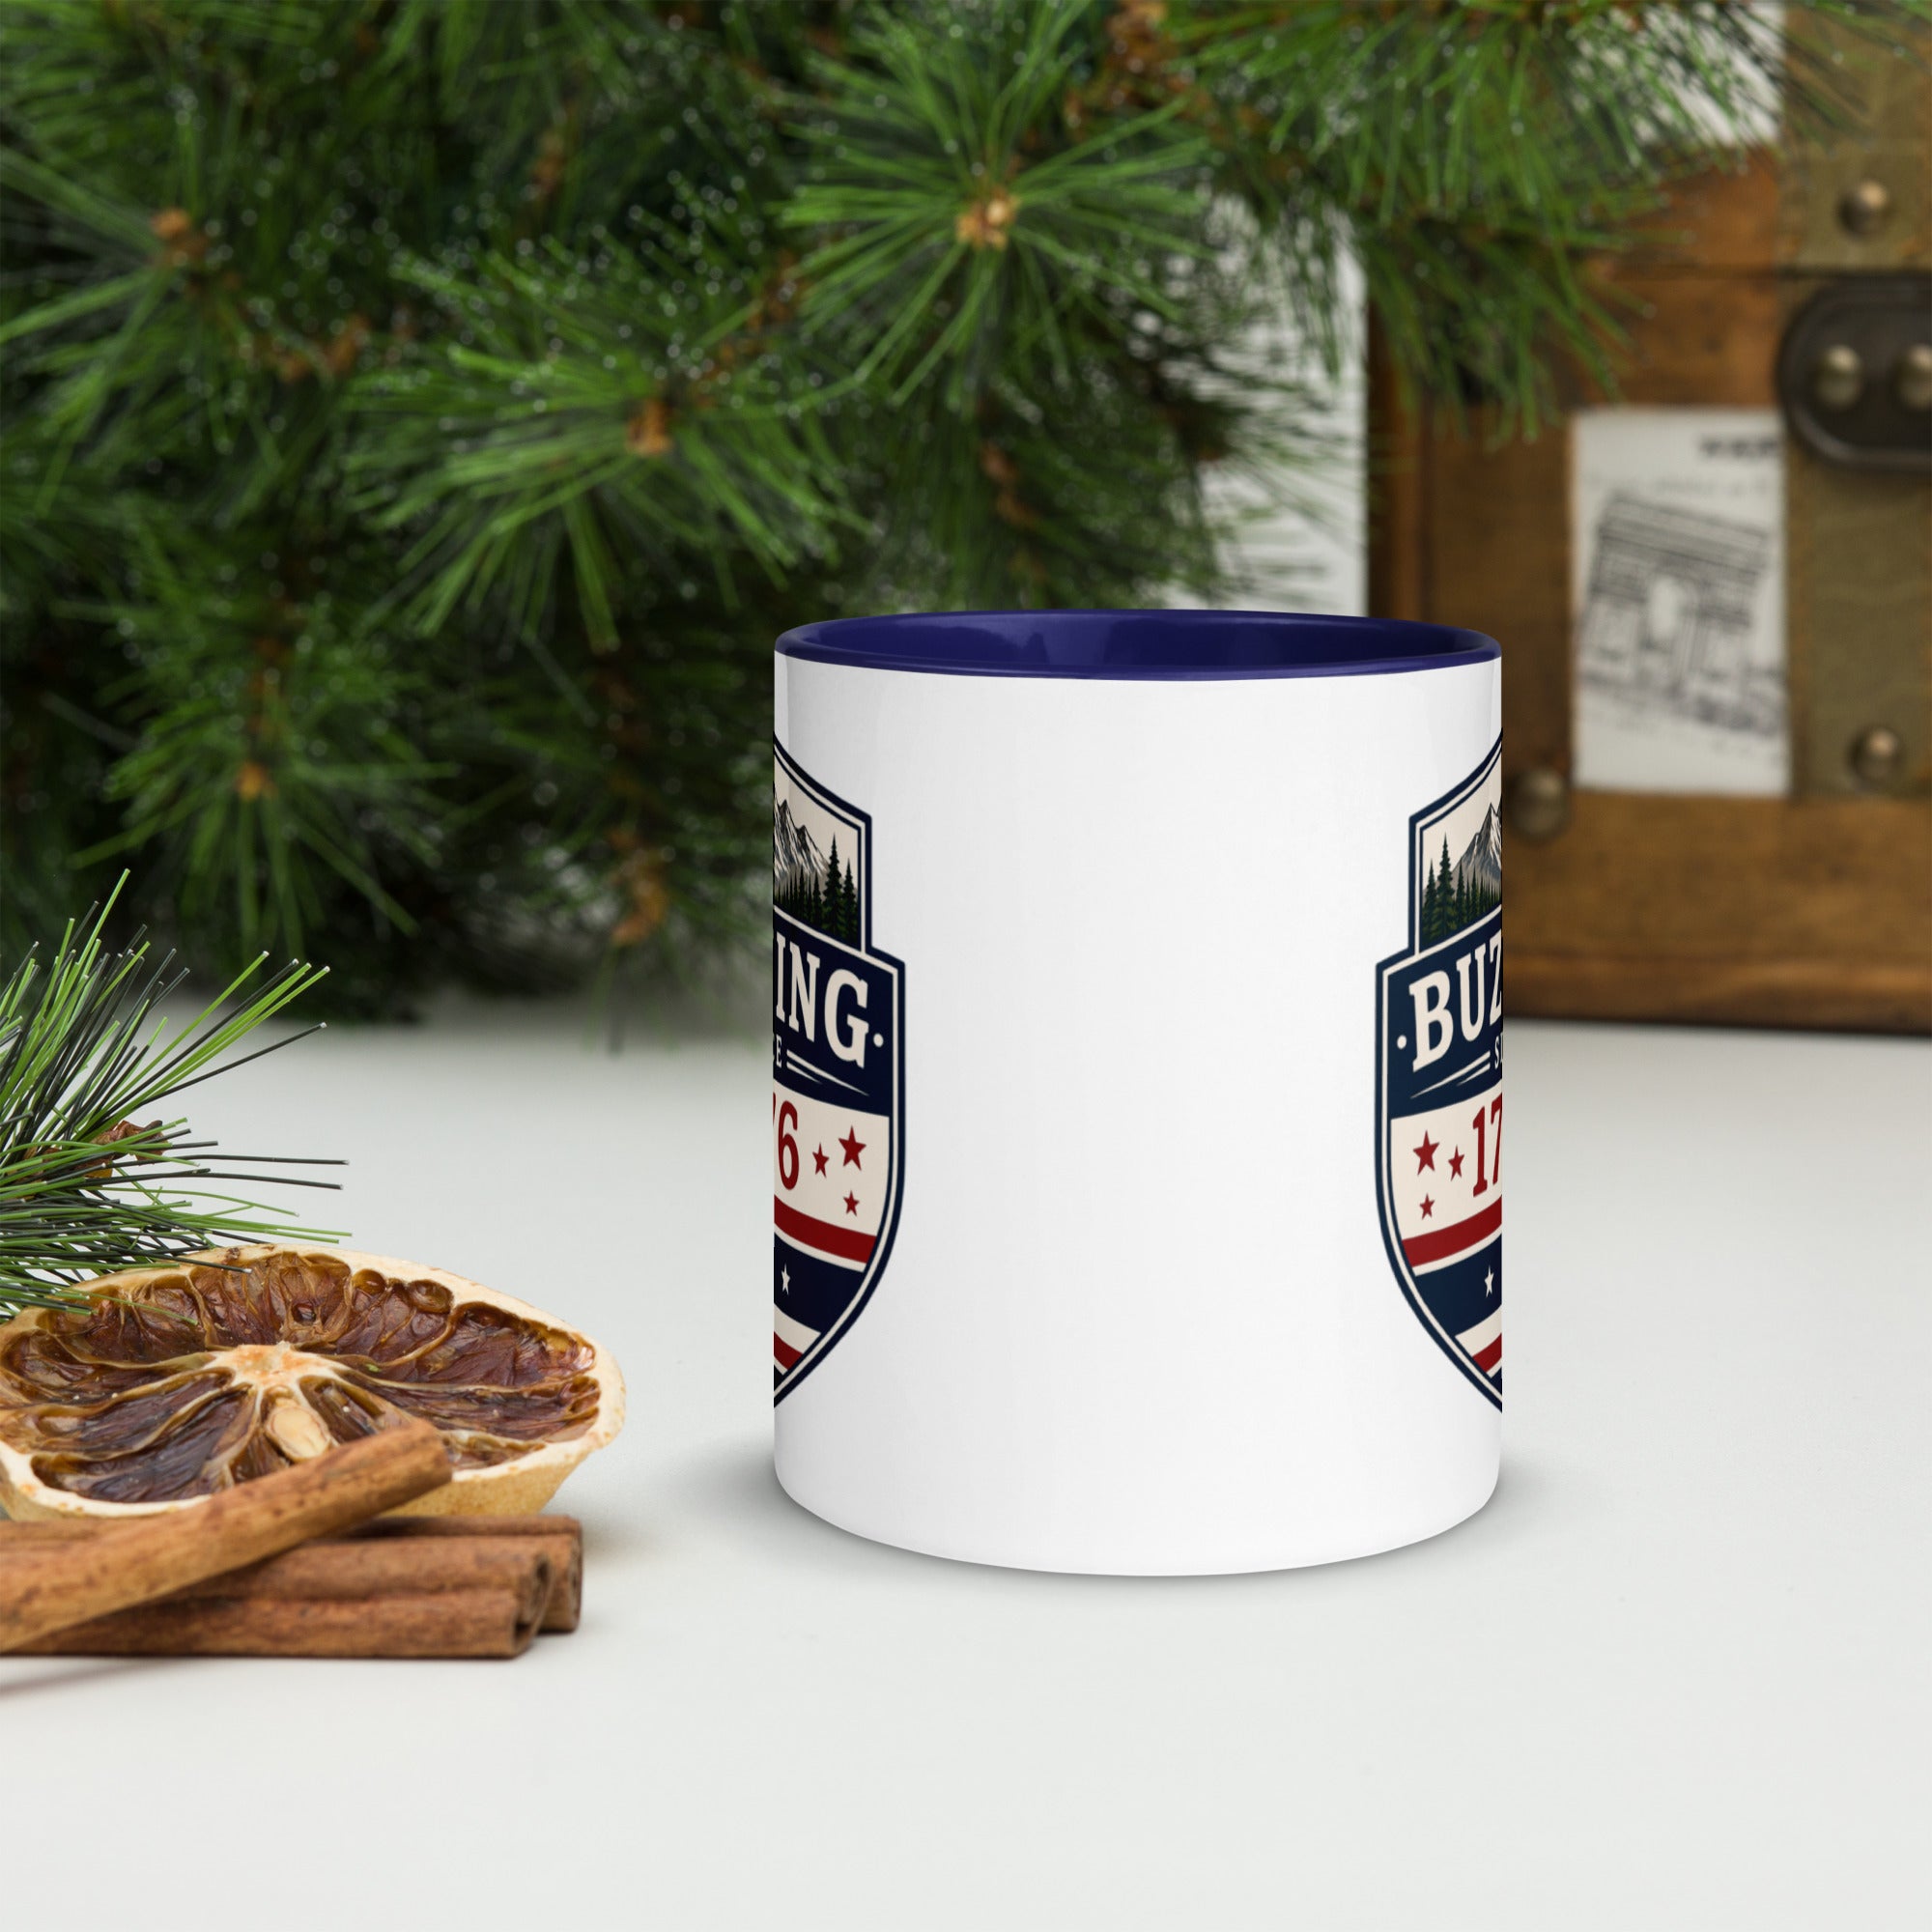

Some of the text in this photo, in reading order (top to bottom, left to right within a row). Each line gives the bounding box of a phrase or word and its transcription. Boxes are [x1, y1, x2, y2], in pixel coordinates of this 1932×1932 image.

[776, 931, 869, 1068] ING
[1408, 928, 1502, 1072] BUZ
[773, 1092, 799, 1190] 6
[1472, 1093, 1502, 1197] 17
